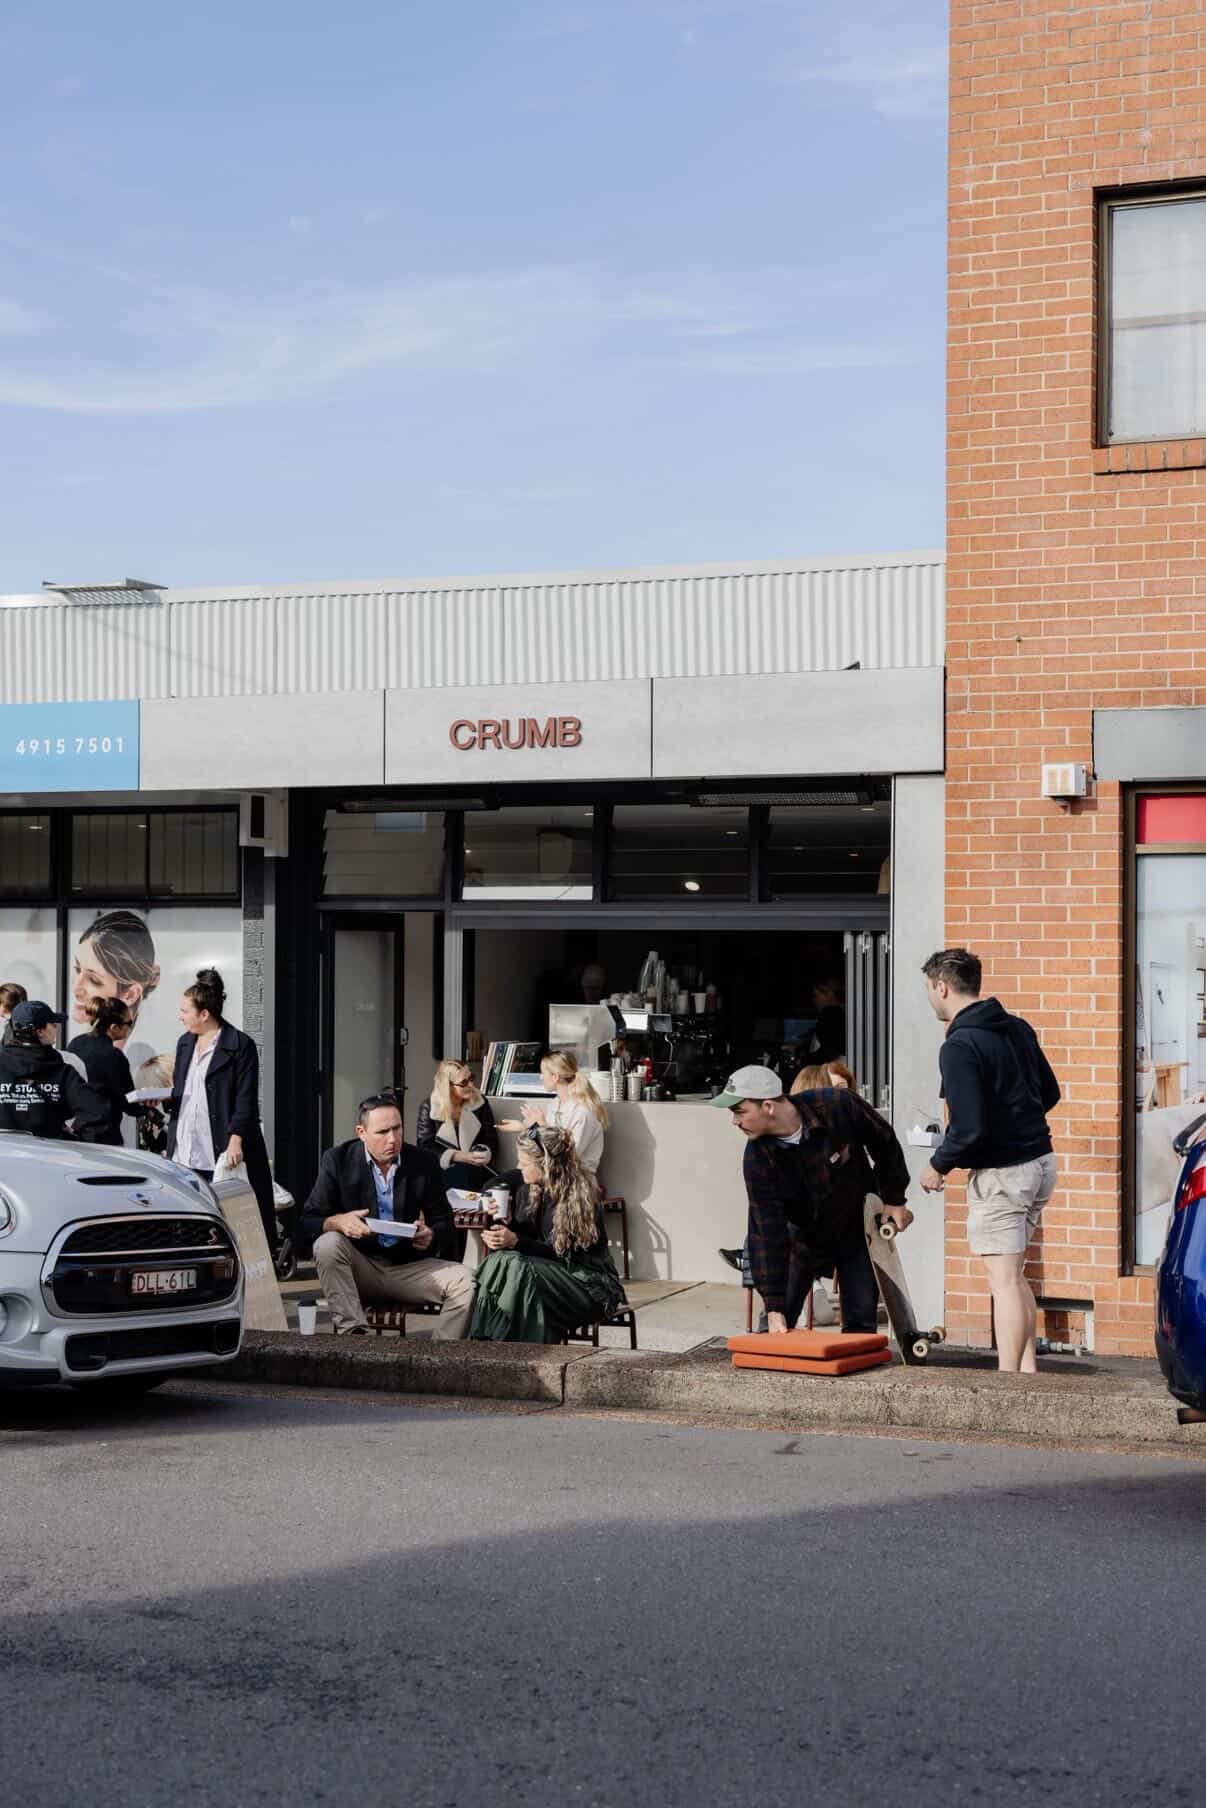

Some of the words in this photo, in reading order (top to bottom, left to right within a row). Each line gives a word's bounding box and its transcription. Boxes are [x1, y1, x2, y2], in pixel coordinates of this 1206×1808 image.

[449, 716, 582, 750] CRUMB
[15, 738, 65, 756] 4915
[74, 736, 124, 753] 7501
[15, 1083, 60, 1093] STUIOS
